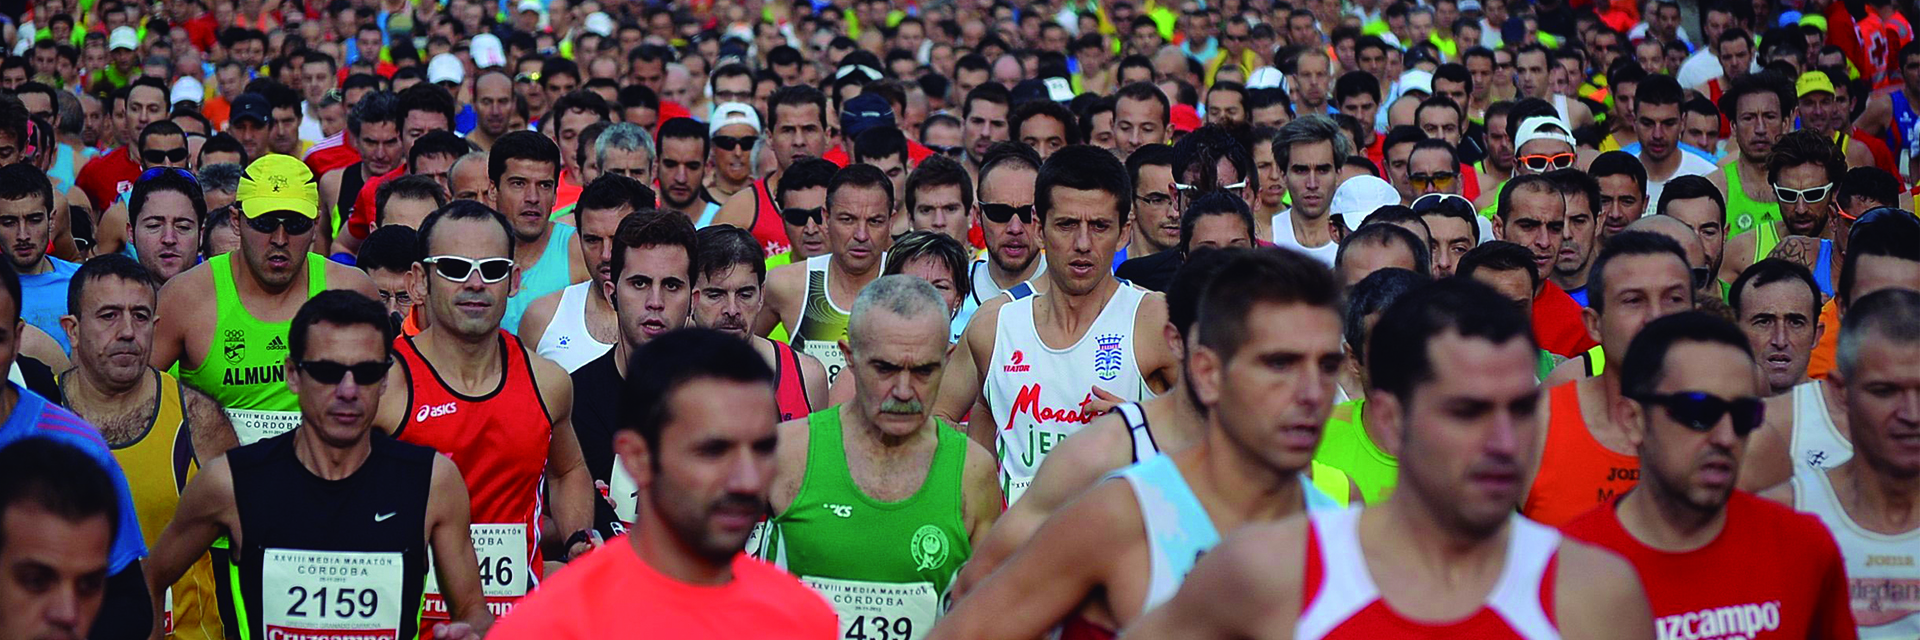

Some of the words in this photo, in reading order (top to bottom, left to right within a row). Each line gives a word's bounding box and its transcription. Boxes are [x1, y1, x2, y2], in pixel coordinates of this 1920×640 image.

[223, 360, 285, 385] ALMUÑ
[430, 401, 457, 418] asics
[308, 556, 340, 564] MEDIA
[297, 564, 368, 576] CÓRDOBA
[844, 586, 877, 594] MEDIA
[286, 586, 379, 619] 2159
[834, 593, 904, 606] CÓRDOBA
[845, 615, 912, 640] 439
